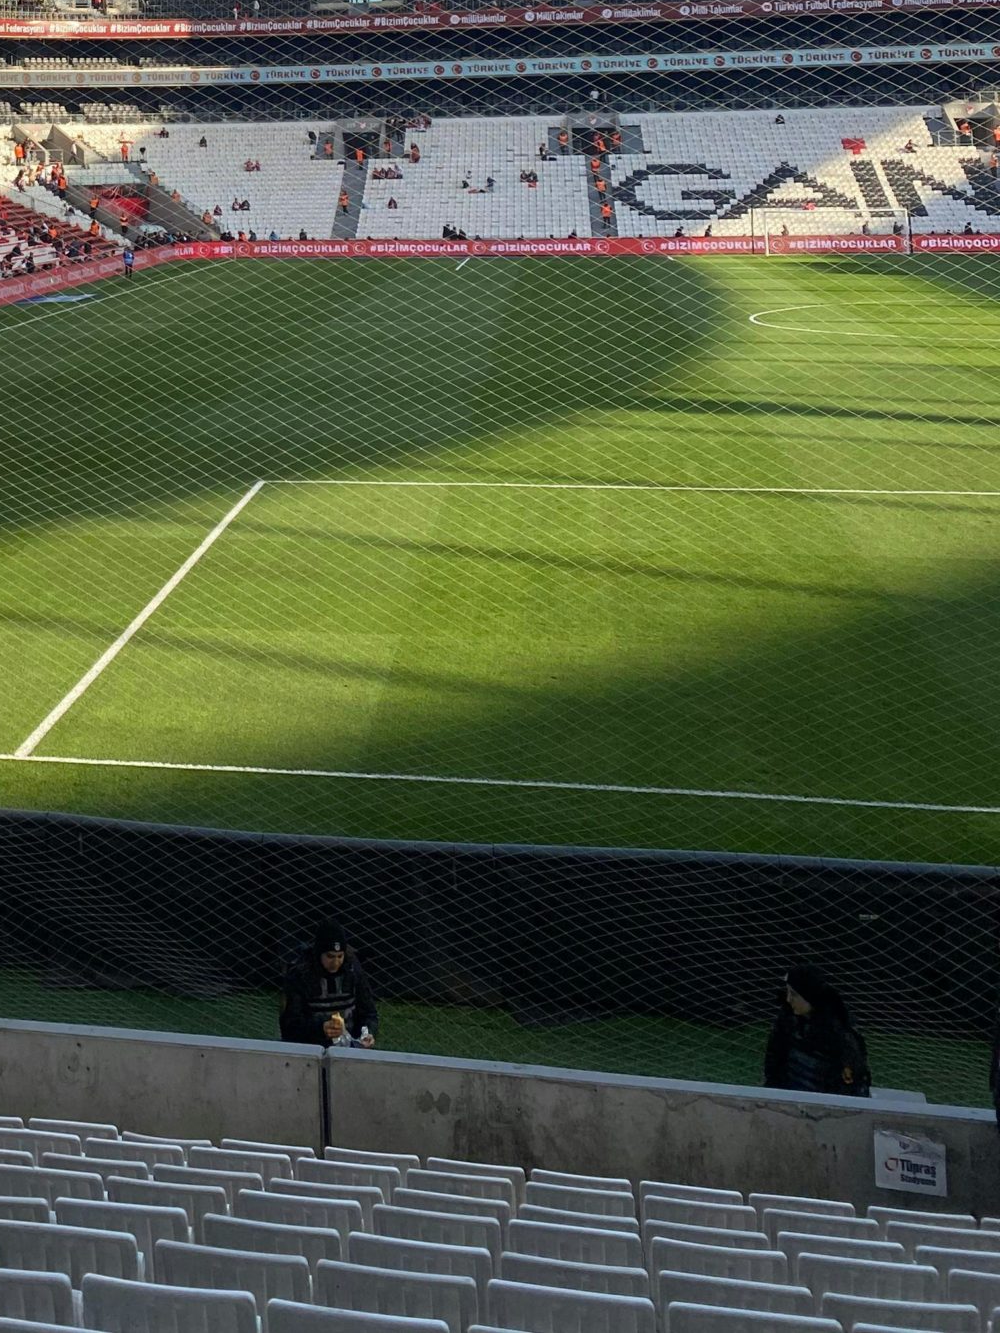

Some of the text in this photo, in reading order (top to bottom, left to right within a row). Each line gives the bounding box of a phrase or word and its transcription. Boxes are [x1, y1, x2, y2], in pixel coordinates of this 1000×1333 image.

[774, 0, 803, 12] Türkiye
[805, 0, 830, 10] Futbol
[205, 71, 245, 81] TÜRKİYE
[920, 237, 1000, 249] #BİZİMÇOCU
[900, 1158, 937, 1178] Tüpraş
